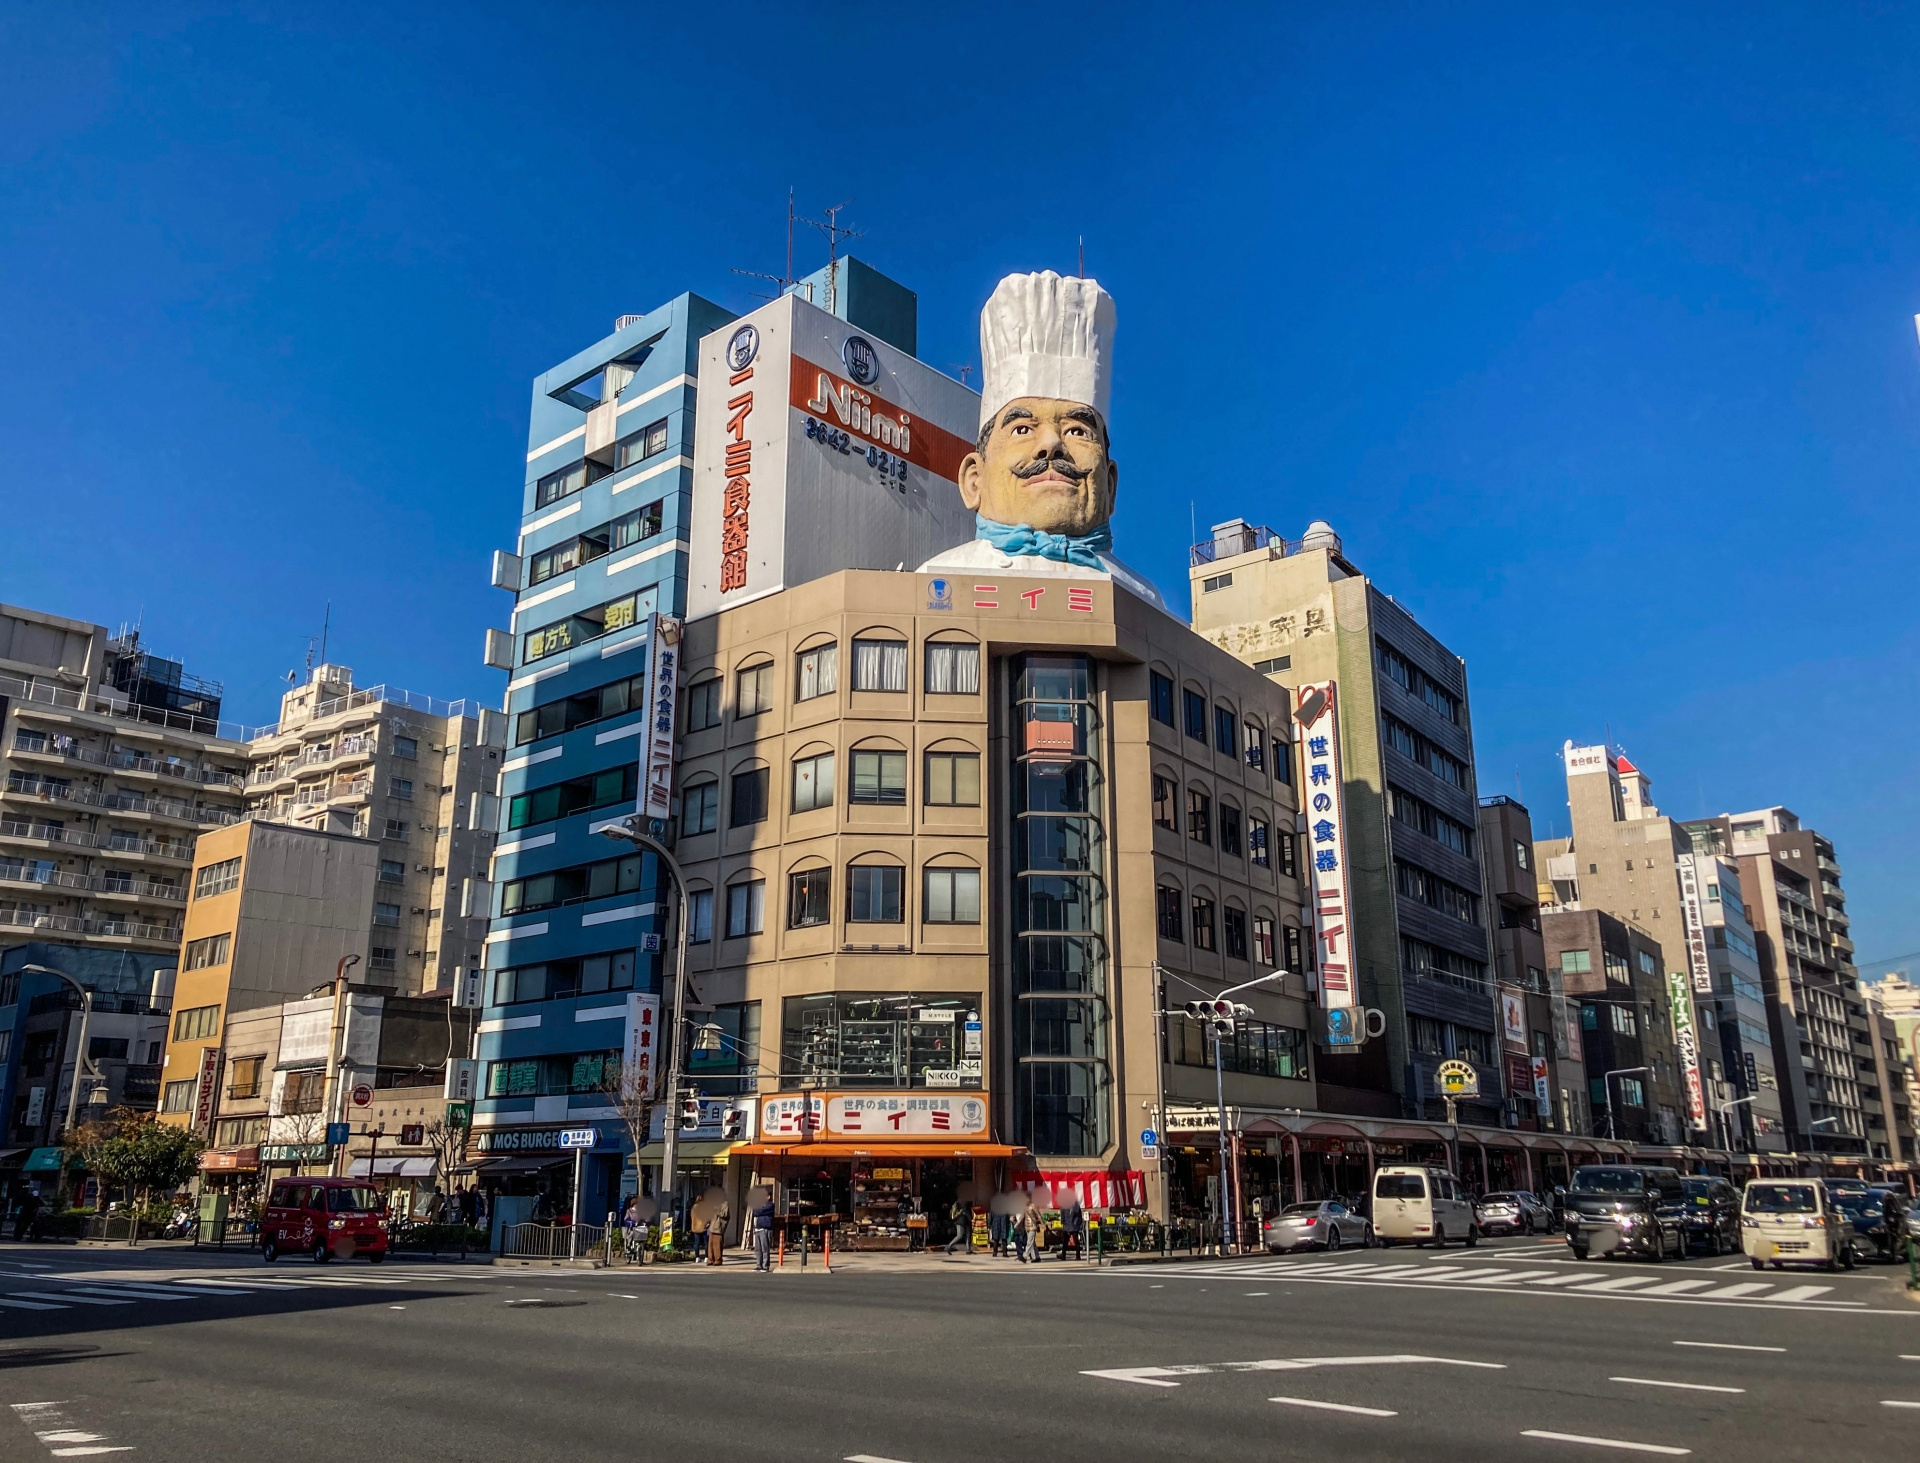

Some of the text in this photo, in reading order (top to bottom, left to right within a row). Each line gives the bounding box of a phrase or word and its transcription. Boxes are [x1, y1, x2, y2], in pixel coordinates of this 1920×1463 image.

[808, 373, 911, 454] Niimi
[720, 366, 754, 594] ニイミ食器館
[974, 585, 1092, 612] ニイミ
[531, 597, 635, 657] 処方せん 受付
[651, 651, 674, 808] 世界の食器 ニイミ
[1308, 735, 1349, 991] 世界の食器 ニイミ
[198, 1050, 217, 1122] 下取・リサイクル
[460, 1069, 469, 1097] 皮膚科
[928, 1072, 958, 1080] NIKKO
[780, 1100, 821, 1131] 世界の食器 ニイミ
[844, 1100, 950, 1111] 世界の食器・調理器具
[843, 1111, 950, 1131] ニイミ
[493, 1132, 559, 1149] MOS BURGE
[279, 1229, 287, 1239] EV
